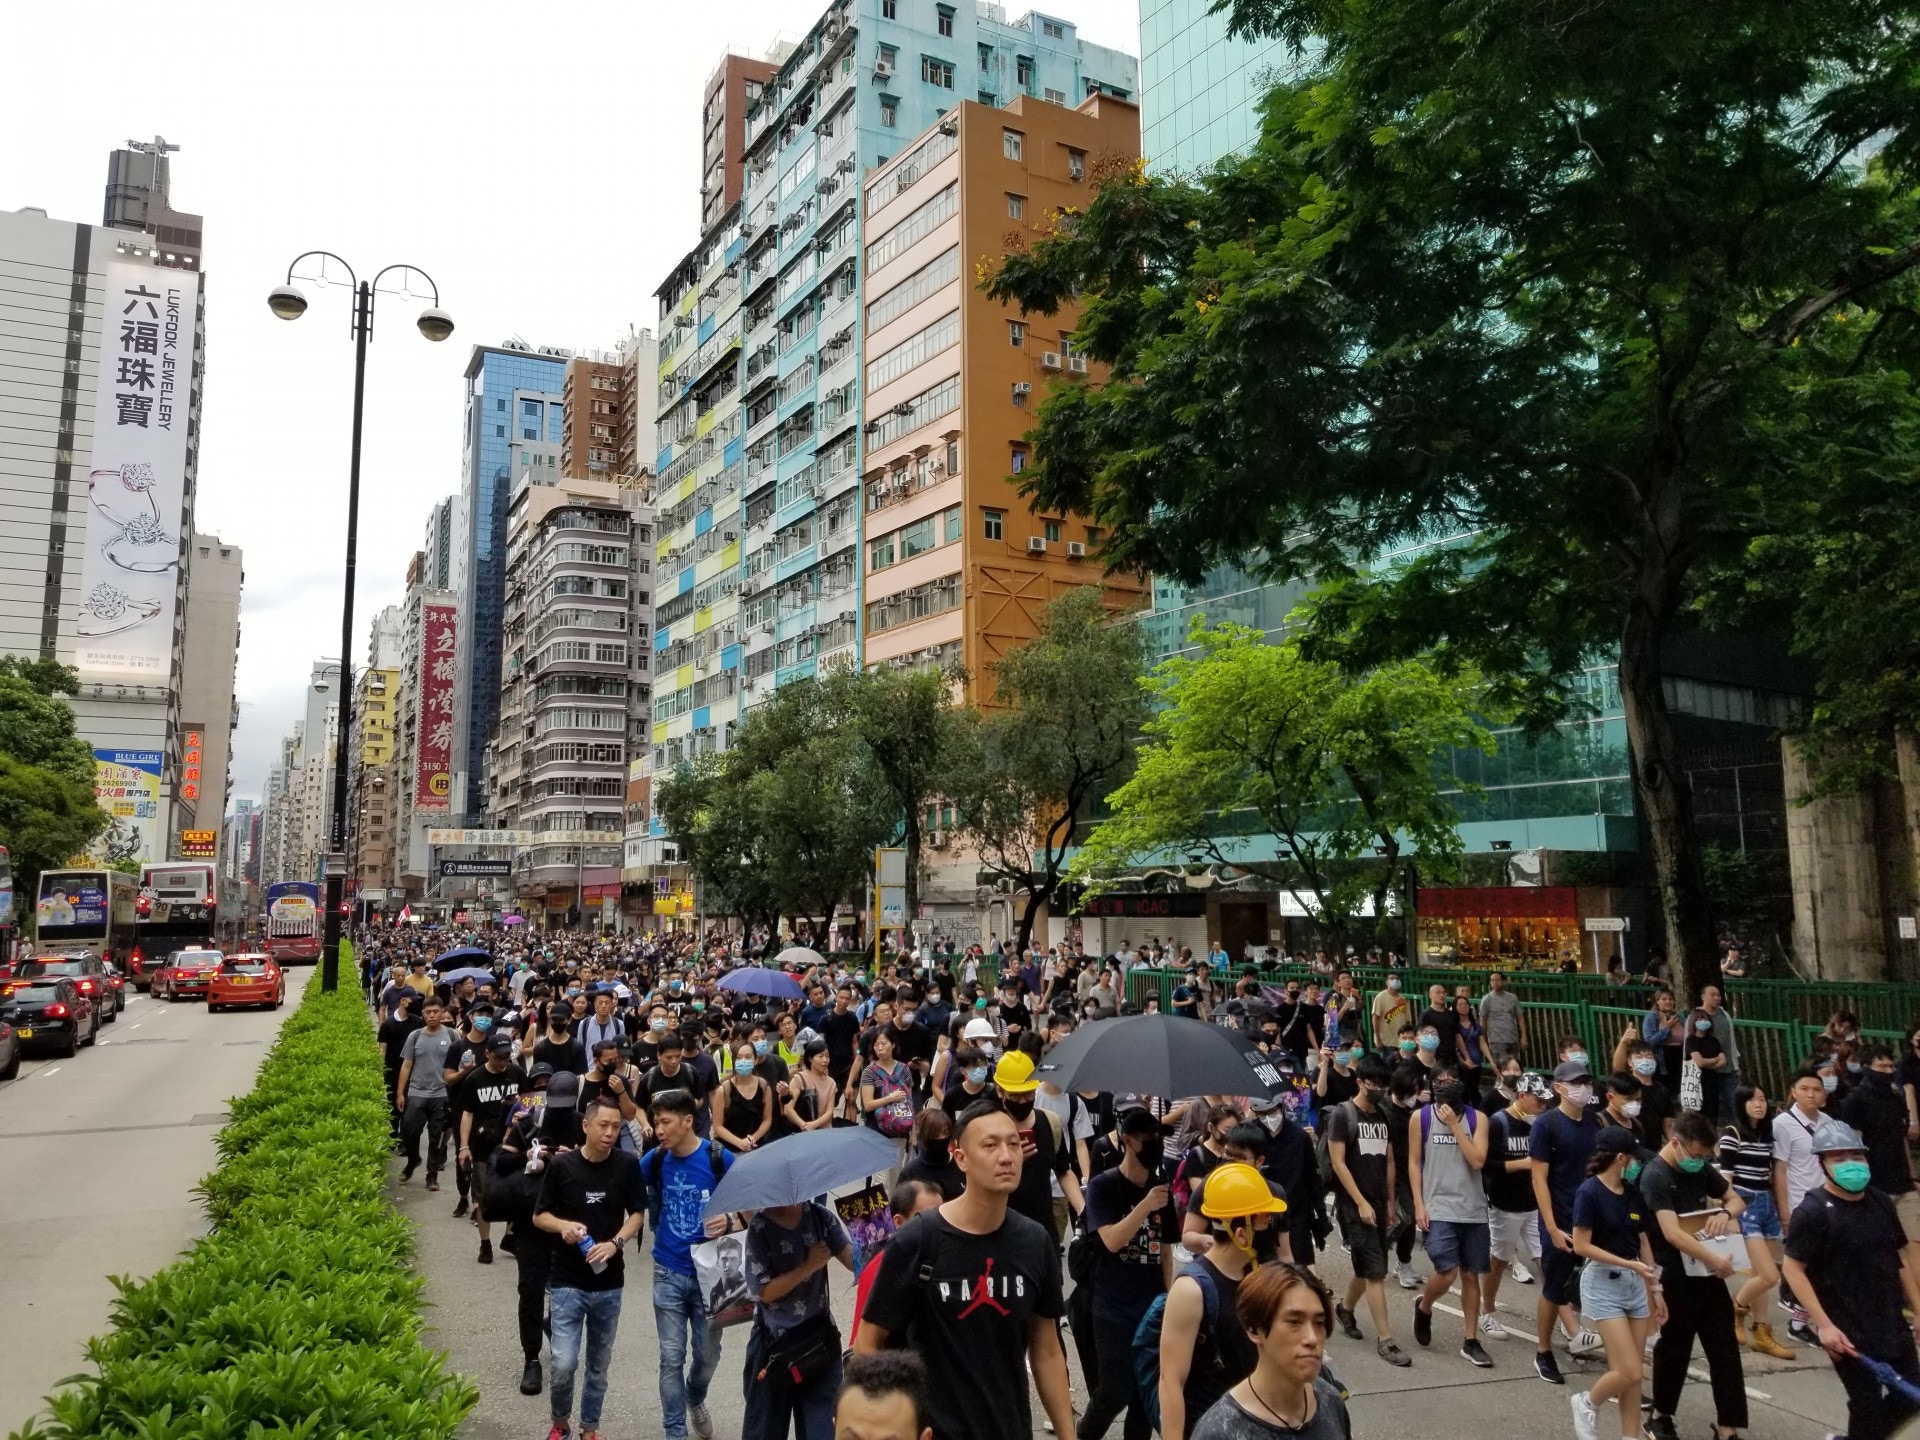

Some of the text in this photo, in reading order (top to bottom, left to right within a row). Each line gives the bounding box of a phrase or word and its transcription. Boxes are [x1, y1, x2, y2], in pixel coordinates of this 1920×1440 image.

[115, 285, 161, 428] 六福珠寶
[158, 288, 180, 431] LUKFOOK JEWELLERY
[422, 762, 441, 771] 3150
[155, 902, 169, 912] 90
[1136, 899, 1169, 914] ICAC
[1253, 1063, 1282, 1087] BMW
[1358, 1122, 1388, 1139] TOKYO
[939, 1275, 1024, 1302] PARIS
